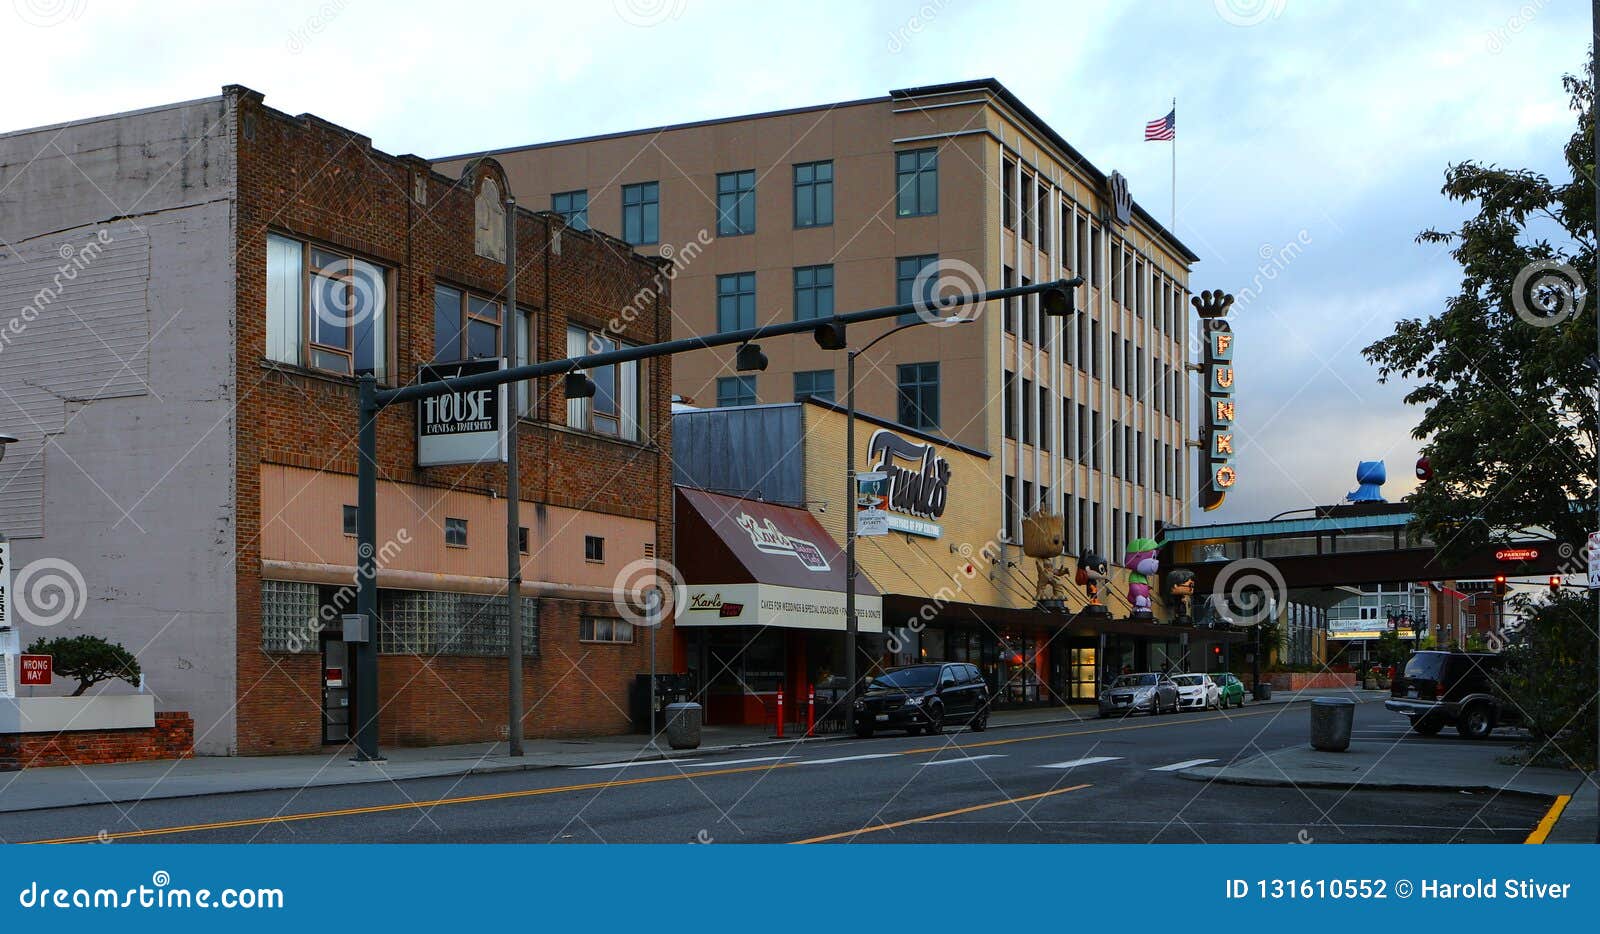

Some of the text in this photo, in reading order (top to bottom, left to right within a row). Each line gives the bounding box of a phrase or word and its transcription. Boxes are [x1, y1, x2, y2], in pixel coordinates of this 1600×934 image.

[424, 390, 492, 423] HOUSE
[1216, 335, 1236, 488] FUNKO
[760, 600, 774, 610] CAKES
[774, 601, 782, 610] FOR
[782, 602, 801, 612] WEDDINGS
[804, 603, 820, 614] SPECIAL
[23, 660, 48, 670] WRONG
[27, 671, 42, 681] WAY
